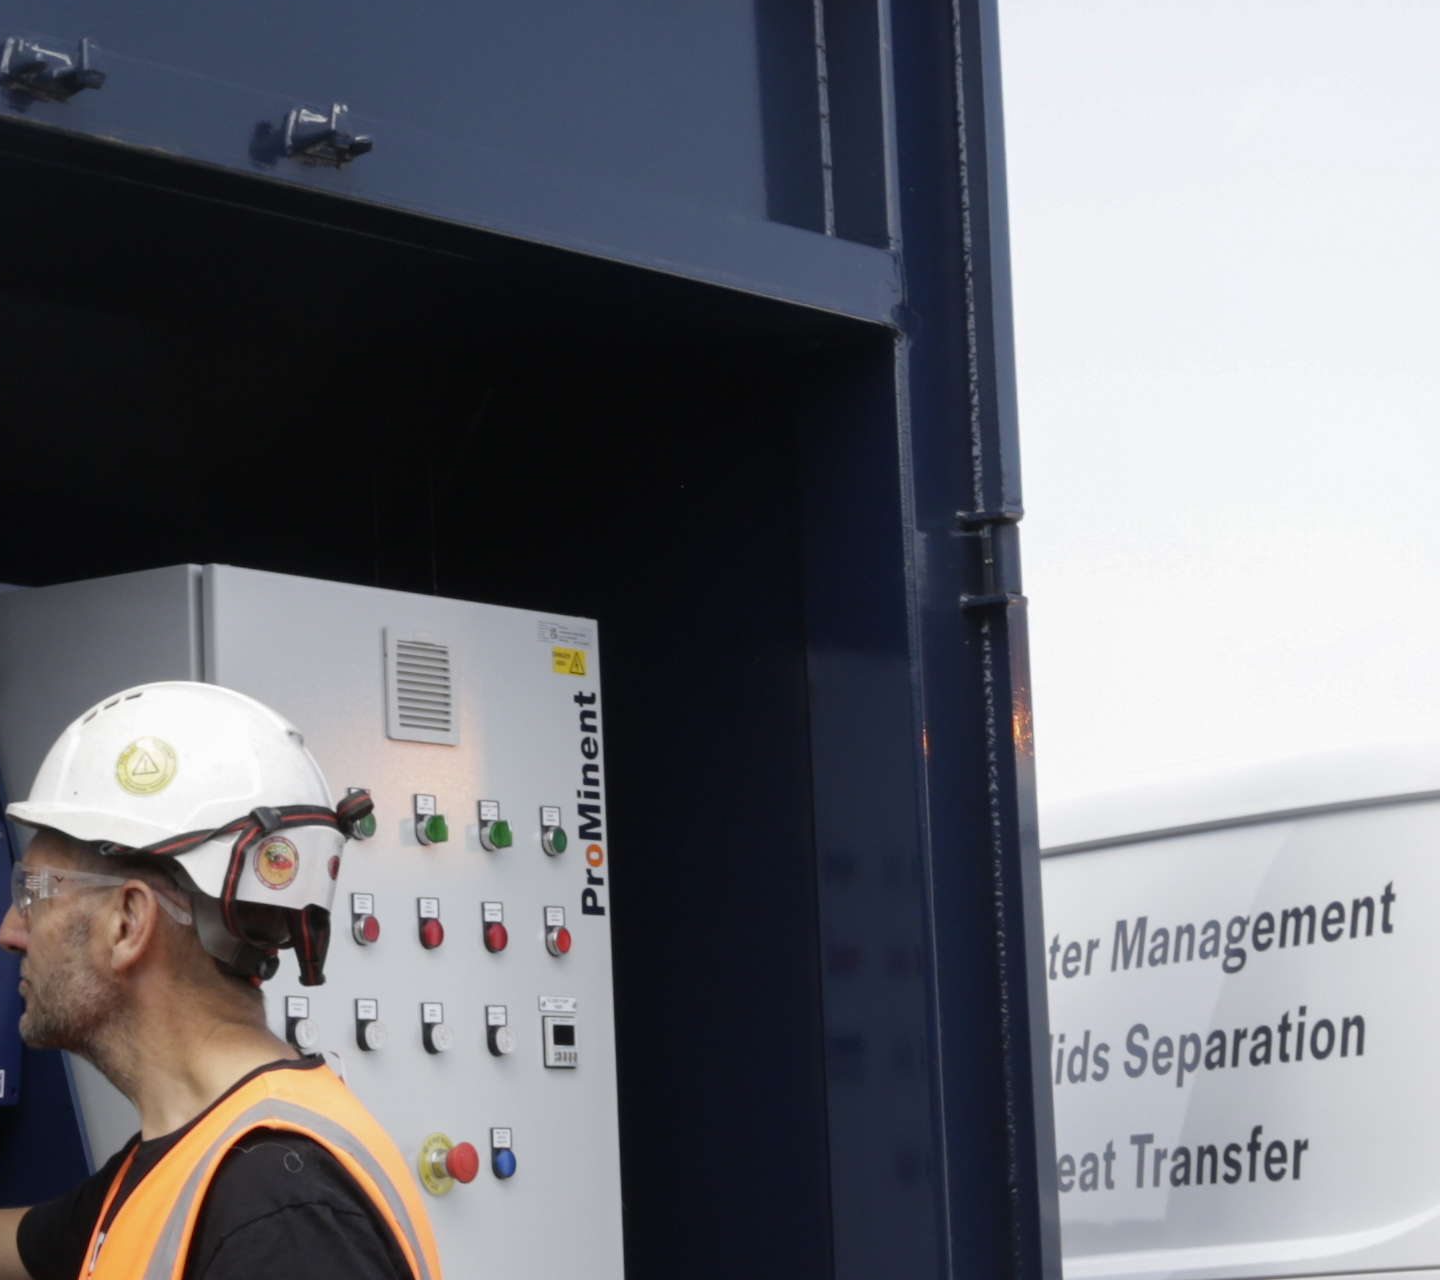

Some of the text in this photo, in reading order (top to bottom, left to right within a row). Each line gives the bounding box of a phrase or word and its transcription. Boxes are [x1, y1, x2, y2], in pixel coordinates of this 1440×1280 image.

[574, 686, 607, 916] ProMinent
[1111, 881, 1396, 975] Management
[1124, 1006, 1366, 1088] Separation
[1129, 1125, 1310, 1189] Transfer
